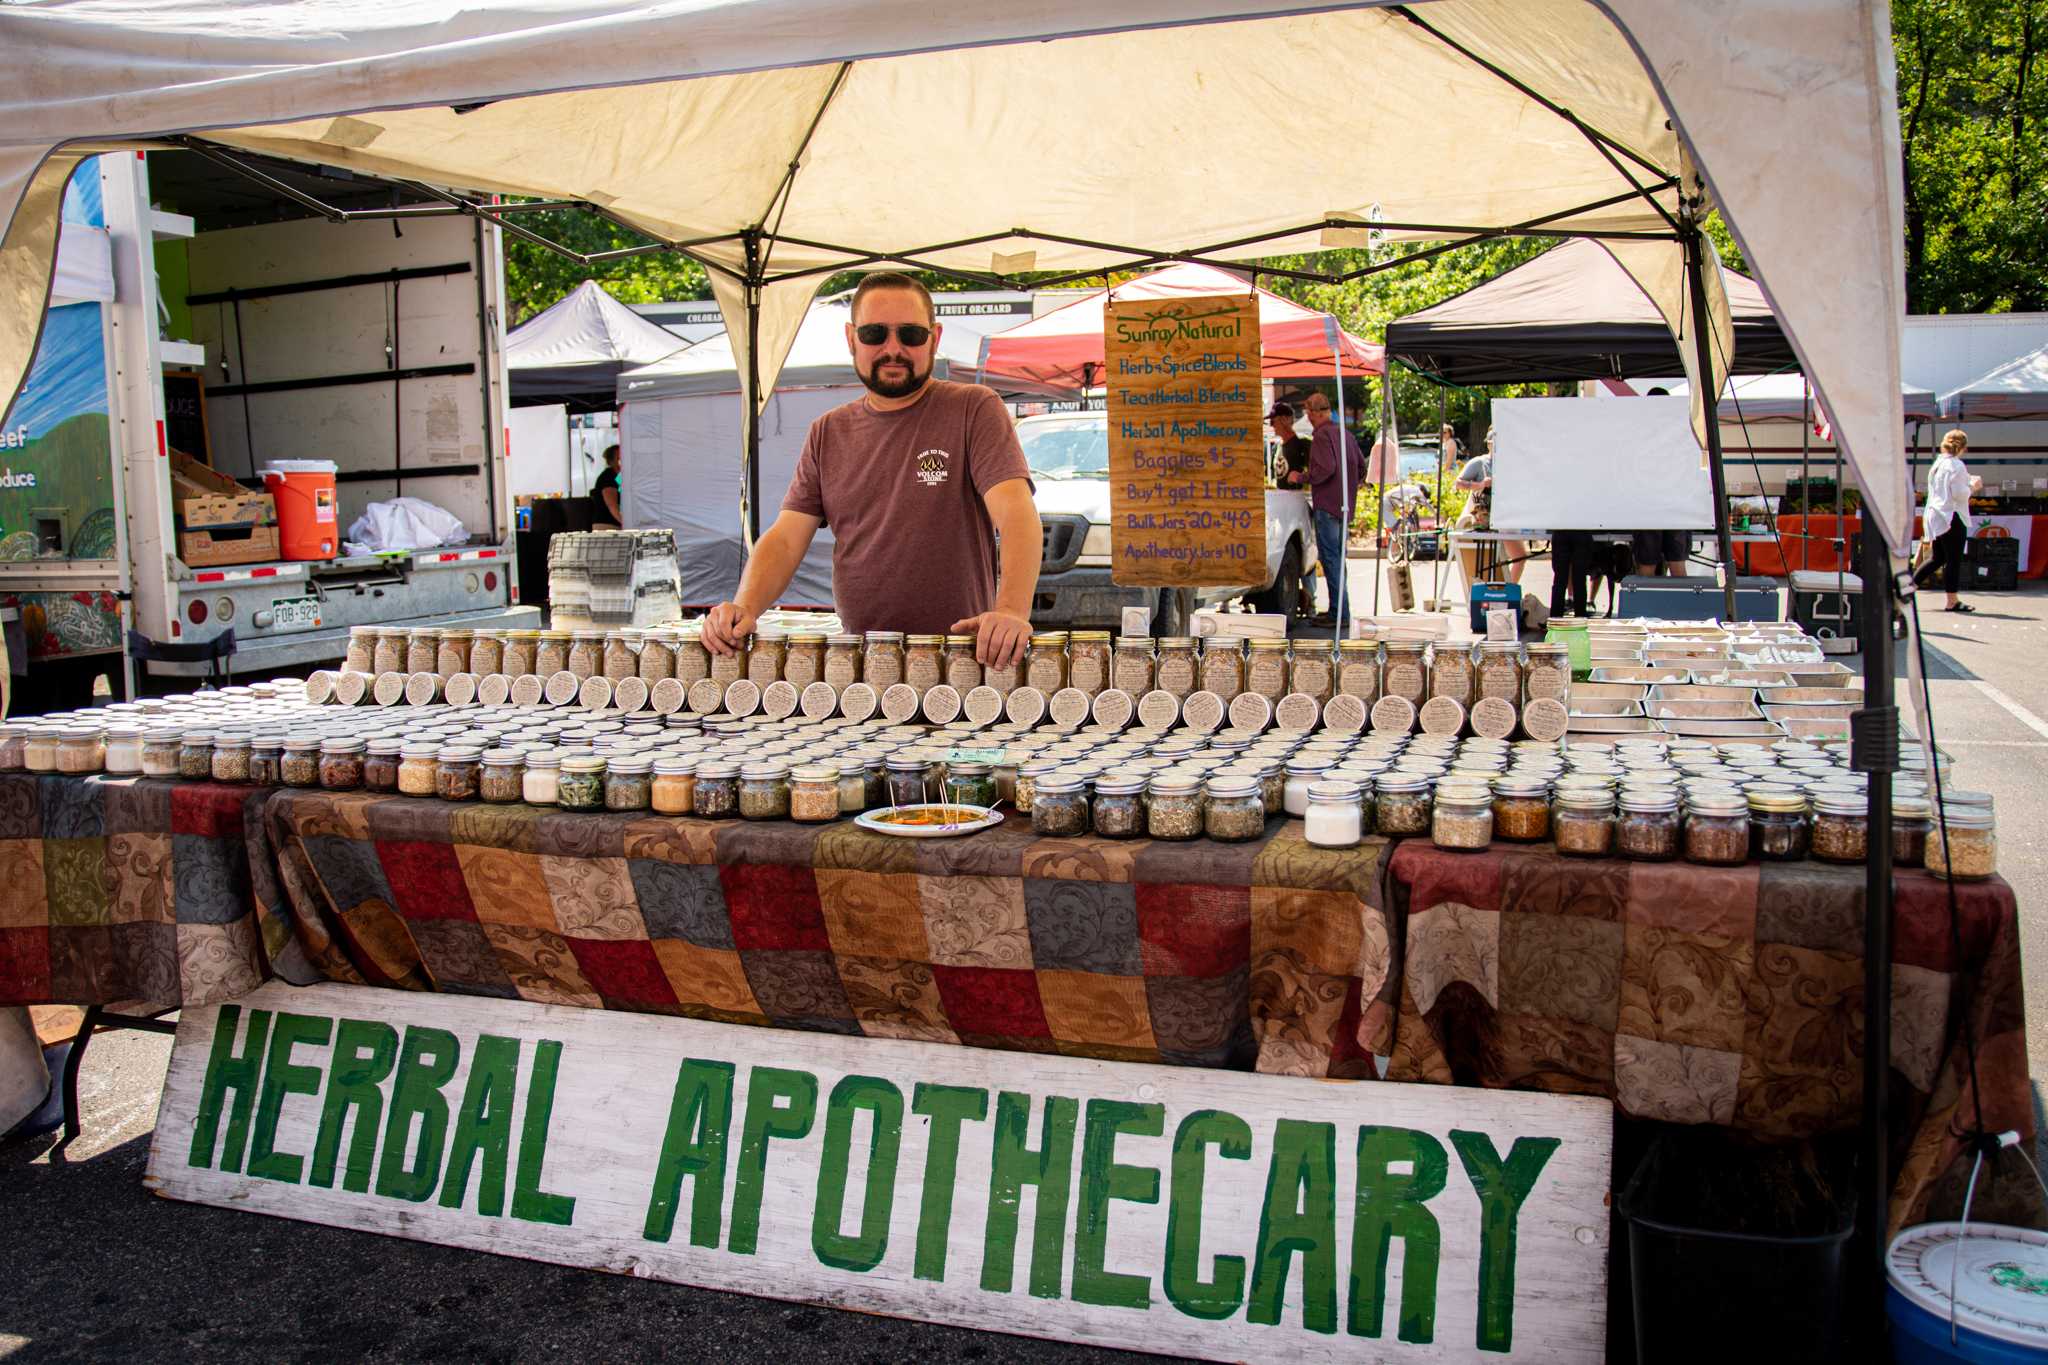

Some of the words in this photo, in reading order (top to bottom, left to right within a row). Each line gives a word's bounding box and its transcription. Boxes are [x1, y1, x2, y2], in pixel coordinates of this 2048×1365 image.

[940, 305, 967, 315] FRUIT
[969, 304, 1012, 314] ORCHARD
[1117, 323, 1177, 347] Sunray
[1178, 317, 1241, 340] Natural
[1119, 356, 1153, 375] Herb
[1162, 354, 1202, 379] Spice
[1203, 352, 1247, 372] Blends
[1119, 389, 1148, 405] Tea
[1198, 383, 1247, 403] Blends
[1121, 419, 1165, 439] Herbal
[1170, 419, 1249, 444] Apothecary
[1134, 449, 1205, 477] Baggies
[1127, 483, 1153, 503] Buy
[1203, 481, 1212, 499] 1
[1217, 480, 1248, 499] Free
[1127, 513, 1156, 529] Bulk
[1159, 512, 1186, 529] Jars
[1124, 541, 1198, 565] Apothecary
[189, 1012, 574, 1226] HERBAL
[644, 1059, 1560, 1348] APOTHECARY
